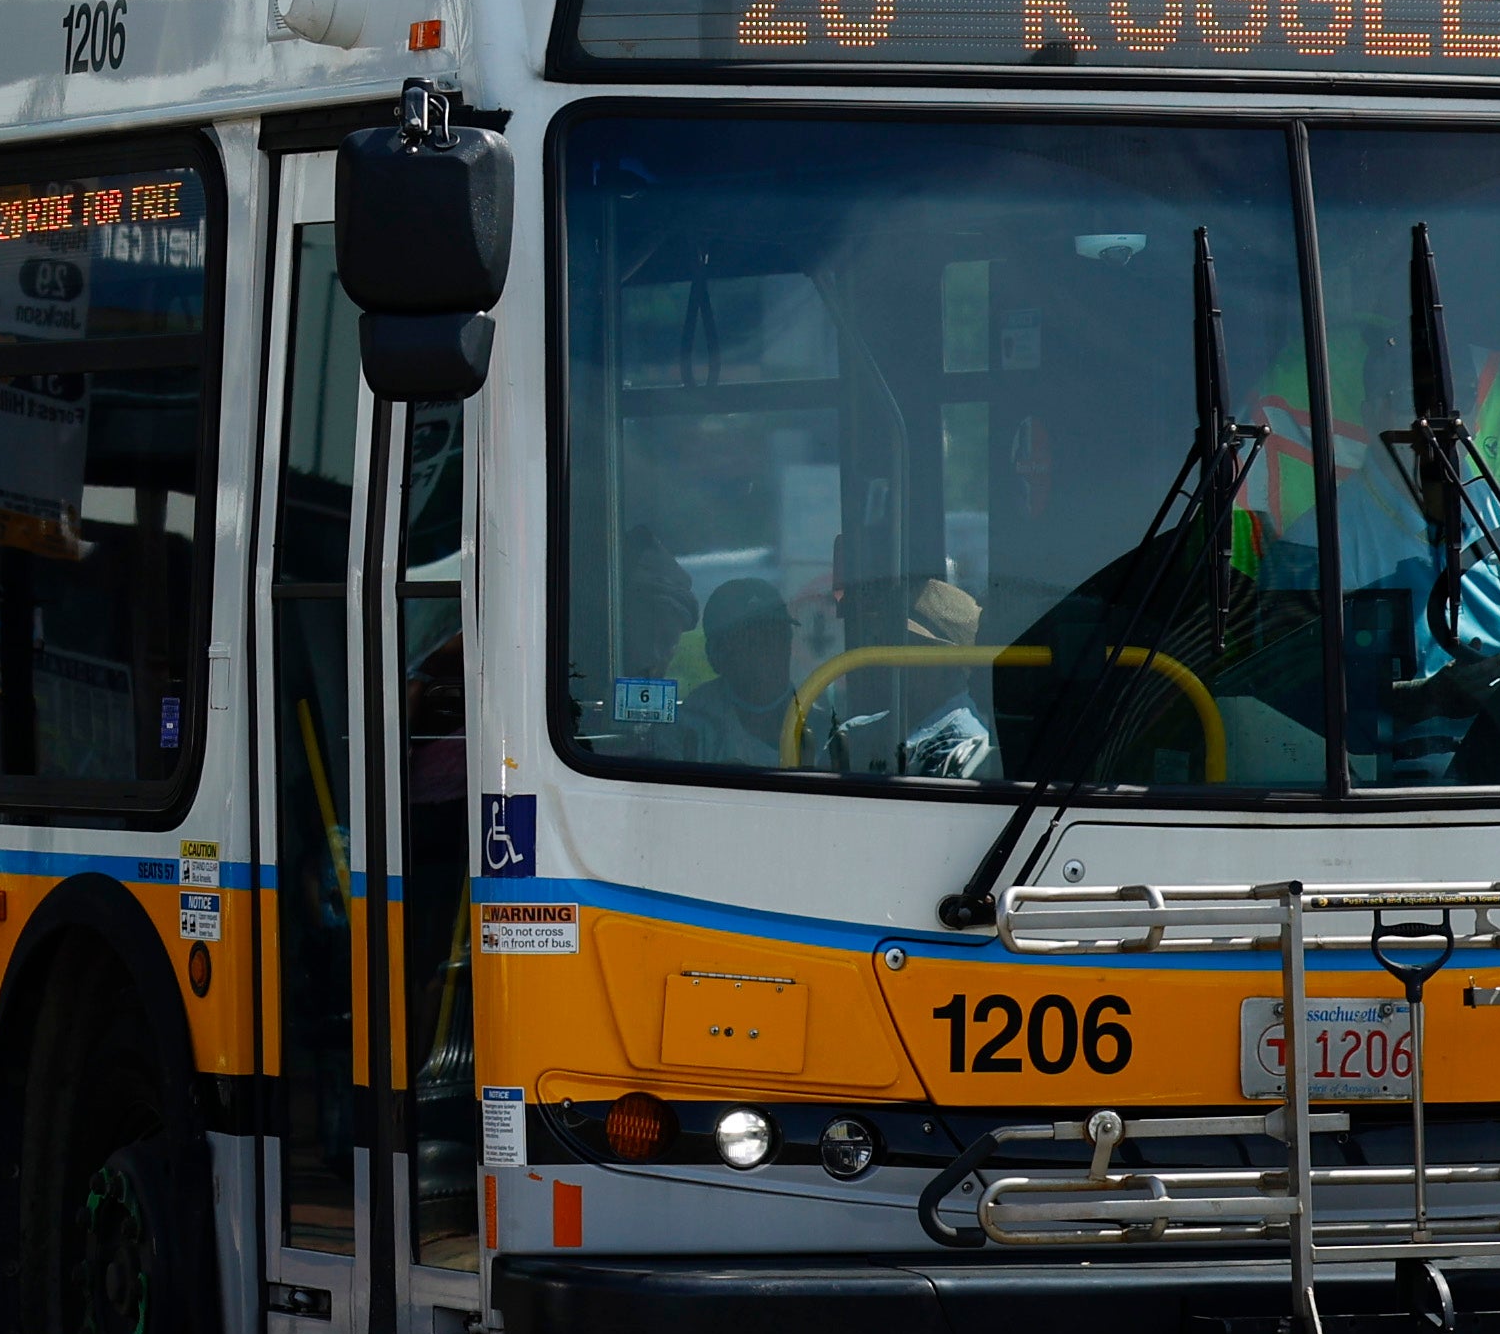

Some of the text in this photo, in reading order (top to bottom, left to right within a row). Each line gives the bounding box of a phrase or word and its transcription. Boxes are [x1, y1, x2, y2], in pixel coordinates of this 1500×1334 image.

[25, 192, 74, 233] RIDE
[82, 189, 121, 226] FOR
[131, 182, 184, 222] FREE
[640, 689, 650, 704] 6
[189, 842, 217, 858] CAUTION
[138, 861, 175, 880] SEATS 57
[188, 895, 212, 910] NOTICE
[1343, 895, 1500, 905] Push rack and squeeze handle to lower
[491, 907, 572, 922] WARNING
[502, 926, 565, 937] Do not cross
[501, 938, 574, 948] in front of bus.
[1306, 1006, 1384, 1023] ssachusetts
[931, 993, 1134, 1075] 1206
[1314, 1029, 1413, 1078] 1206
[1307, 1084, 1327, 1094] pirit
[1342, 1083, 1381, 1094] America
